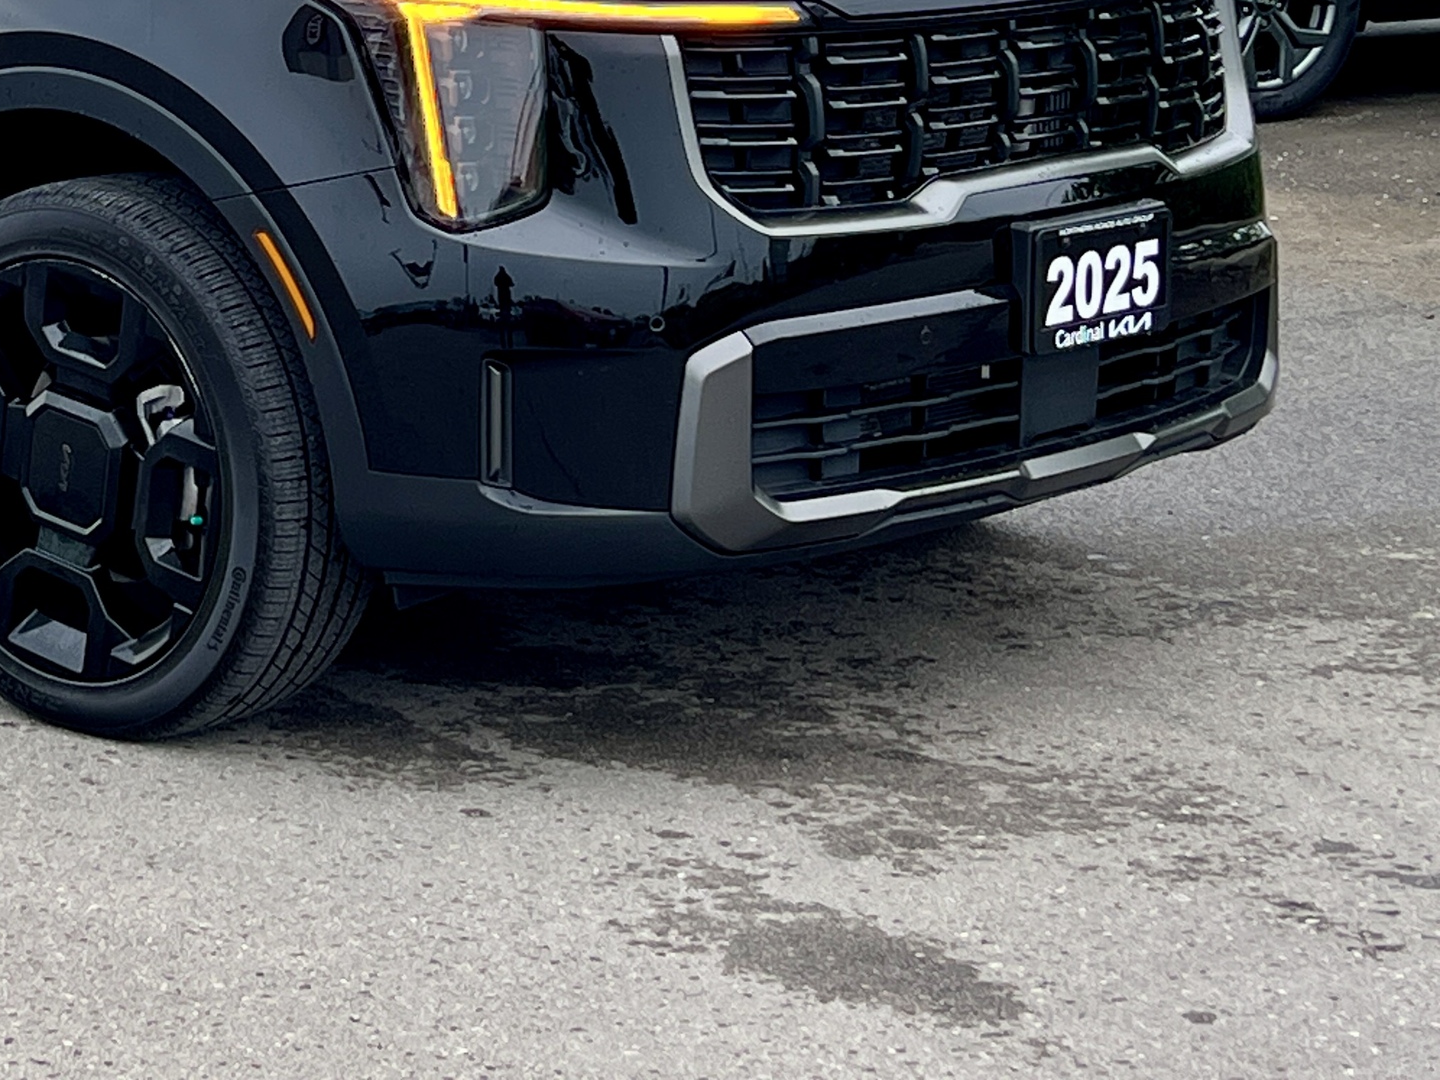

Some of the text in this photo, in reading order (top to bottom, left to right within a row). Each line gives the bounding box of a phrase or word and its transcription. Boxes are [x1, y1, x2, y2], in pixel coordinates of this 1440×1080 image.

[1045, 238, 1160, 327] 2025
[1055, 312, 1152, 348] Cardinal KIA
